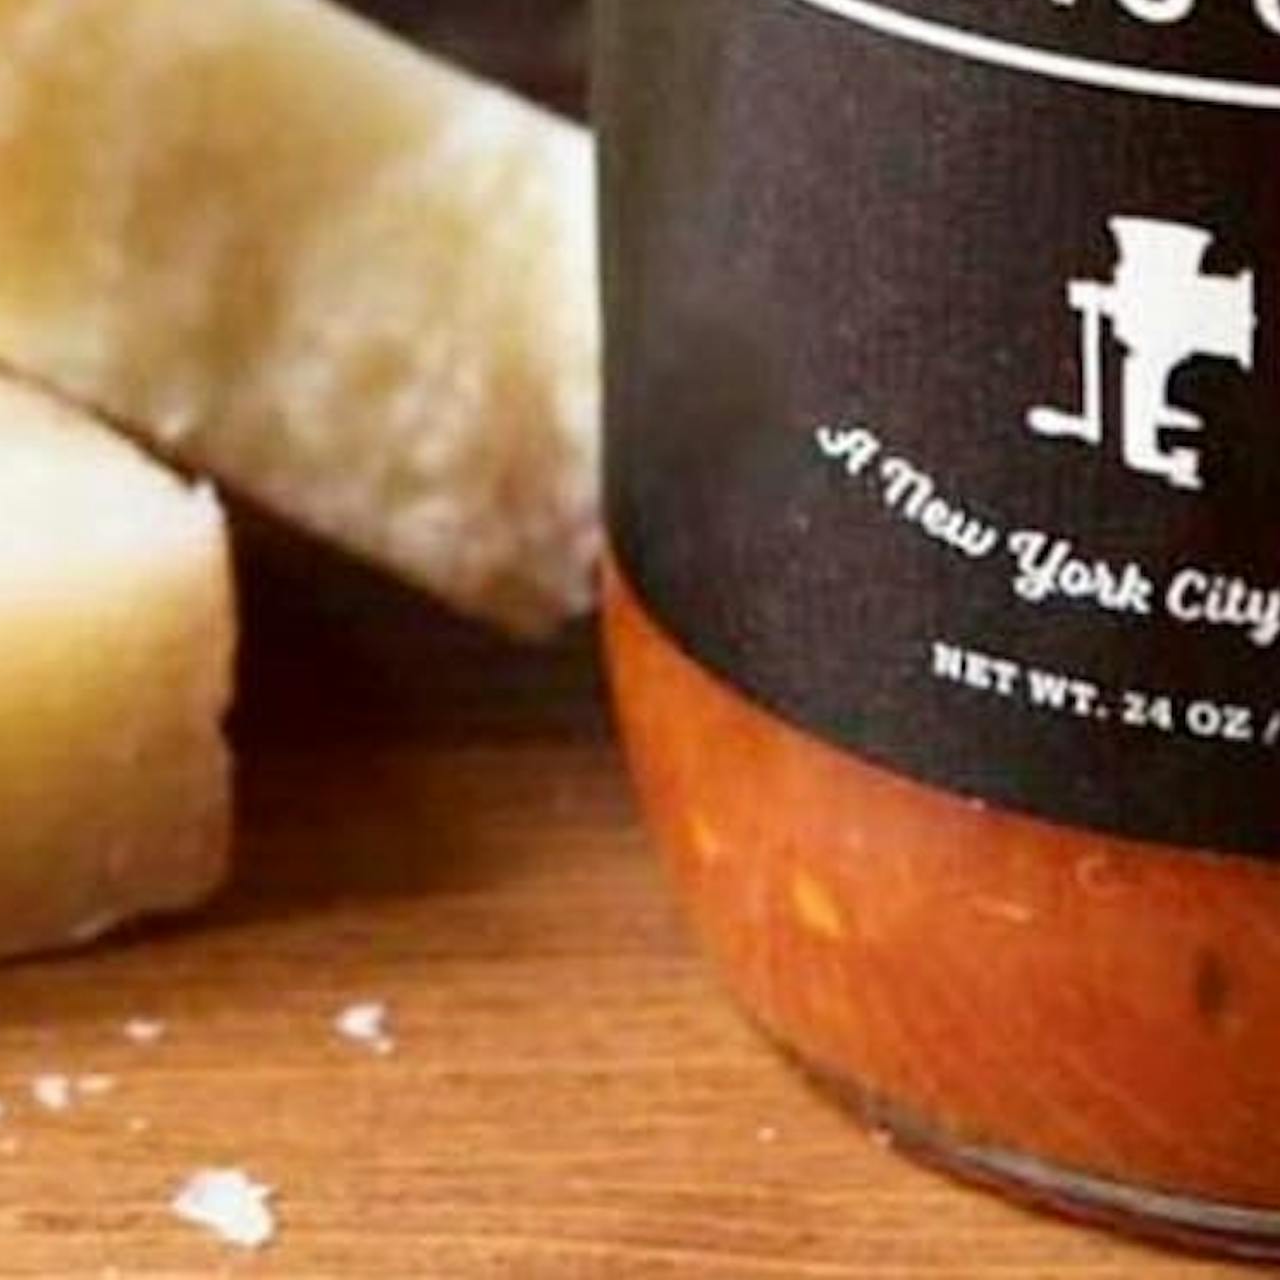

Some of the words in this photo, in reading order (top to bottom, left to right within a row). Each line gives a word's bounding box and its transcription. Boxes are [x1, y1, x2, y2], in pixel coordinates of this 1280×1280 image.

[815, 424, 881, 477] A
[879, 455, 1000, 558] New
[1006, 529, 1155, 616] York
[931, 640, 1020, 696] NET
[1026, 668, 1109, 719] WT.
[1121, 690, 1174, 730] 24
[1184, 700, 1253, 741] OZ
